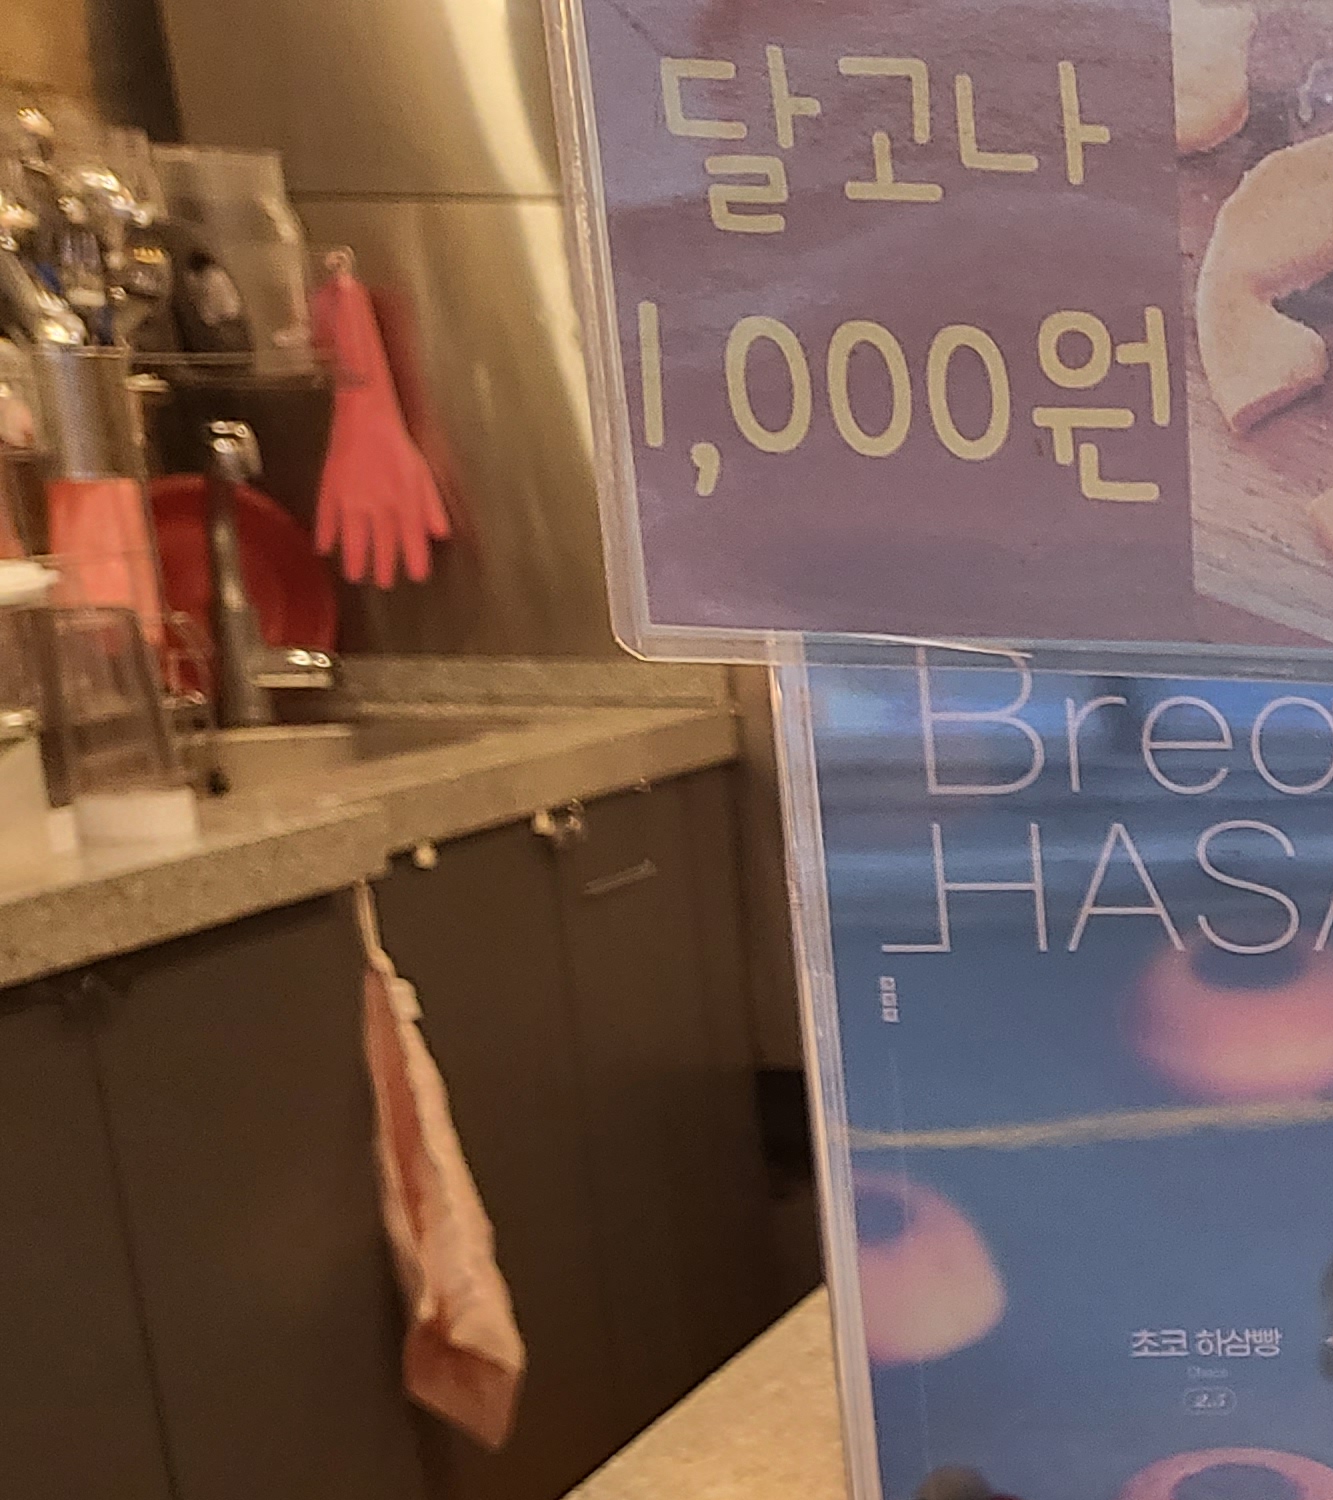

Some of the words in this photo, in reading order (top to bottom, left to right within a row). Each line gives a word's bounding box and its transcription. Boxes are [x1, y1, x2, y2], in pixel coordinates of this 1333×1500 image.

[657, 43, 1112, 234] 달고나
[637, 300, 1173, 503] 1,000원
[1130, 1329, 1190, 1357] 초코
[1195, 1328, 1283, 1357] 하삼빵
